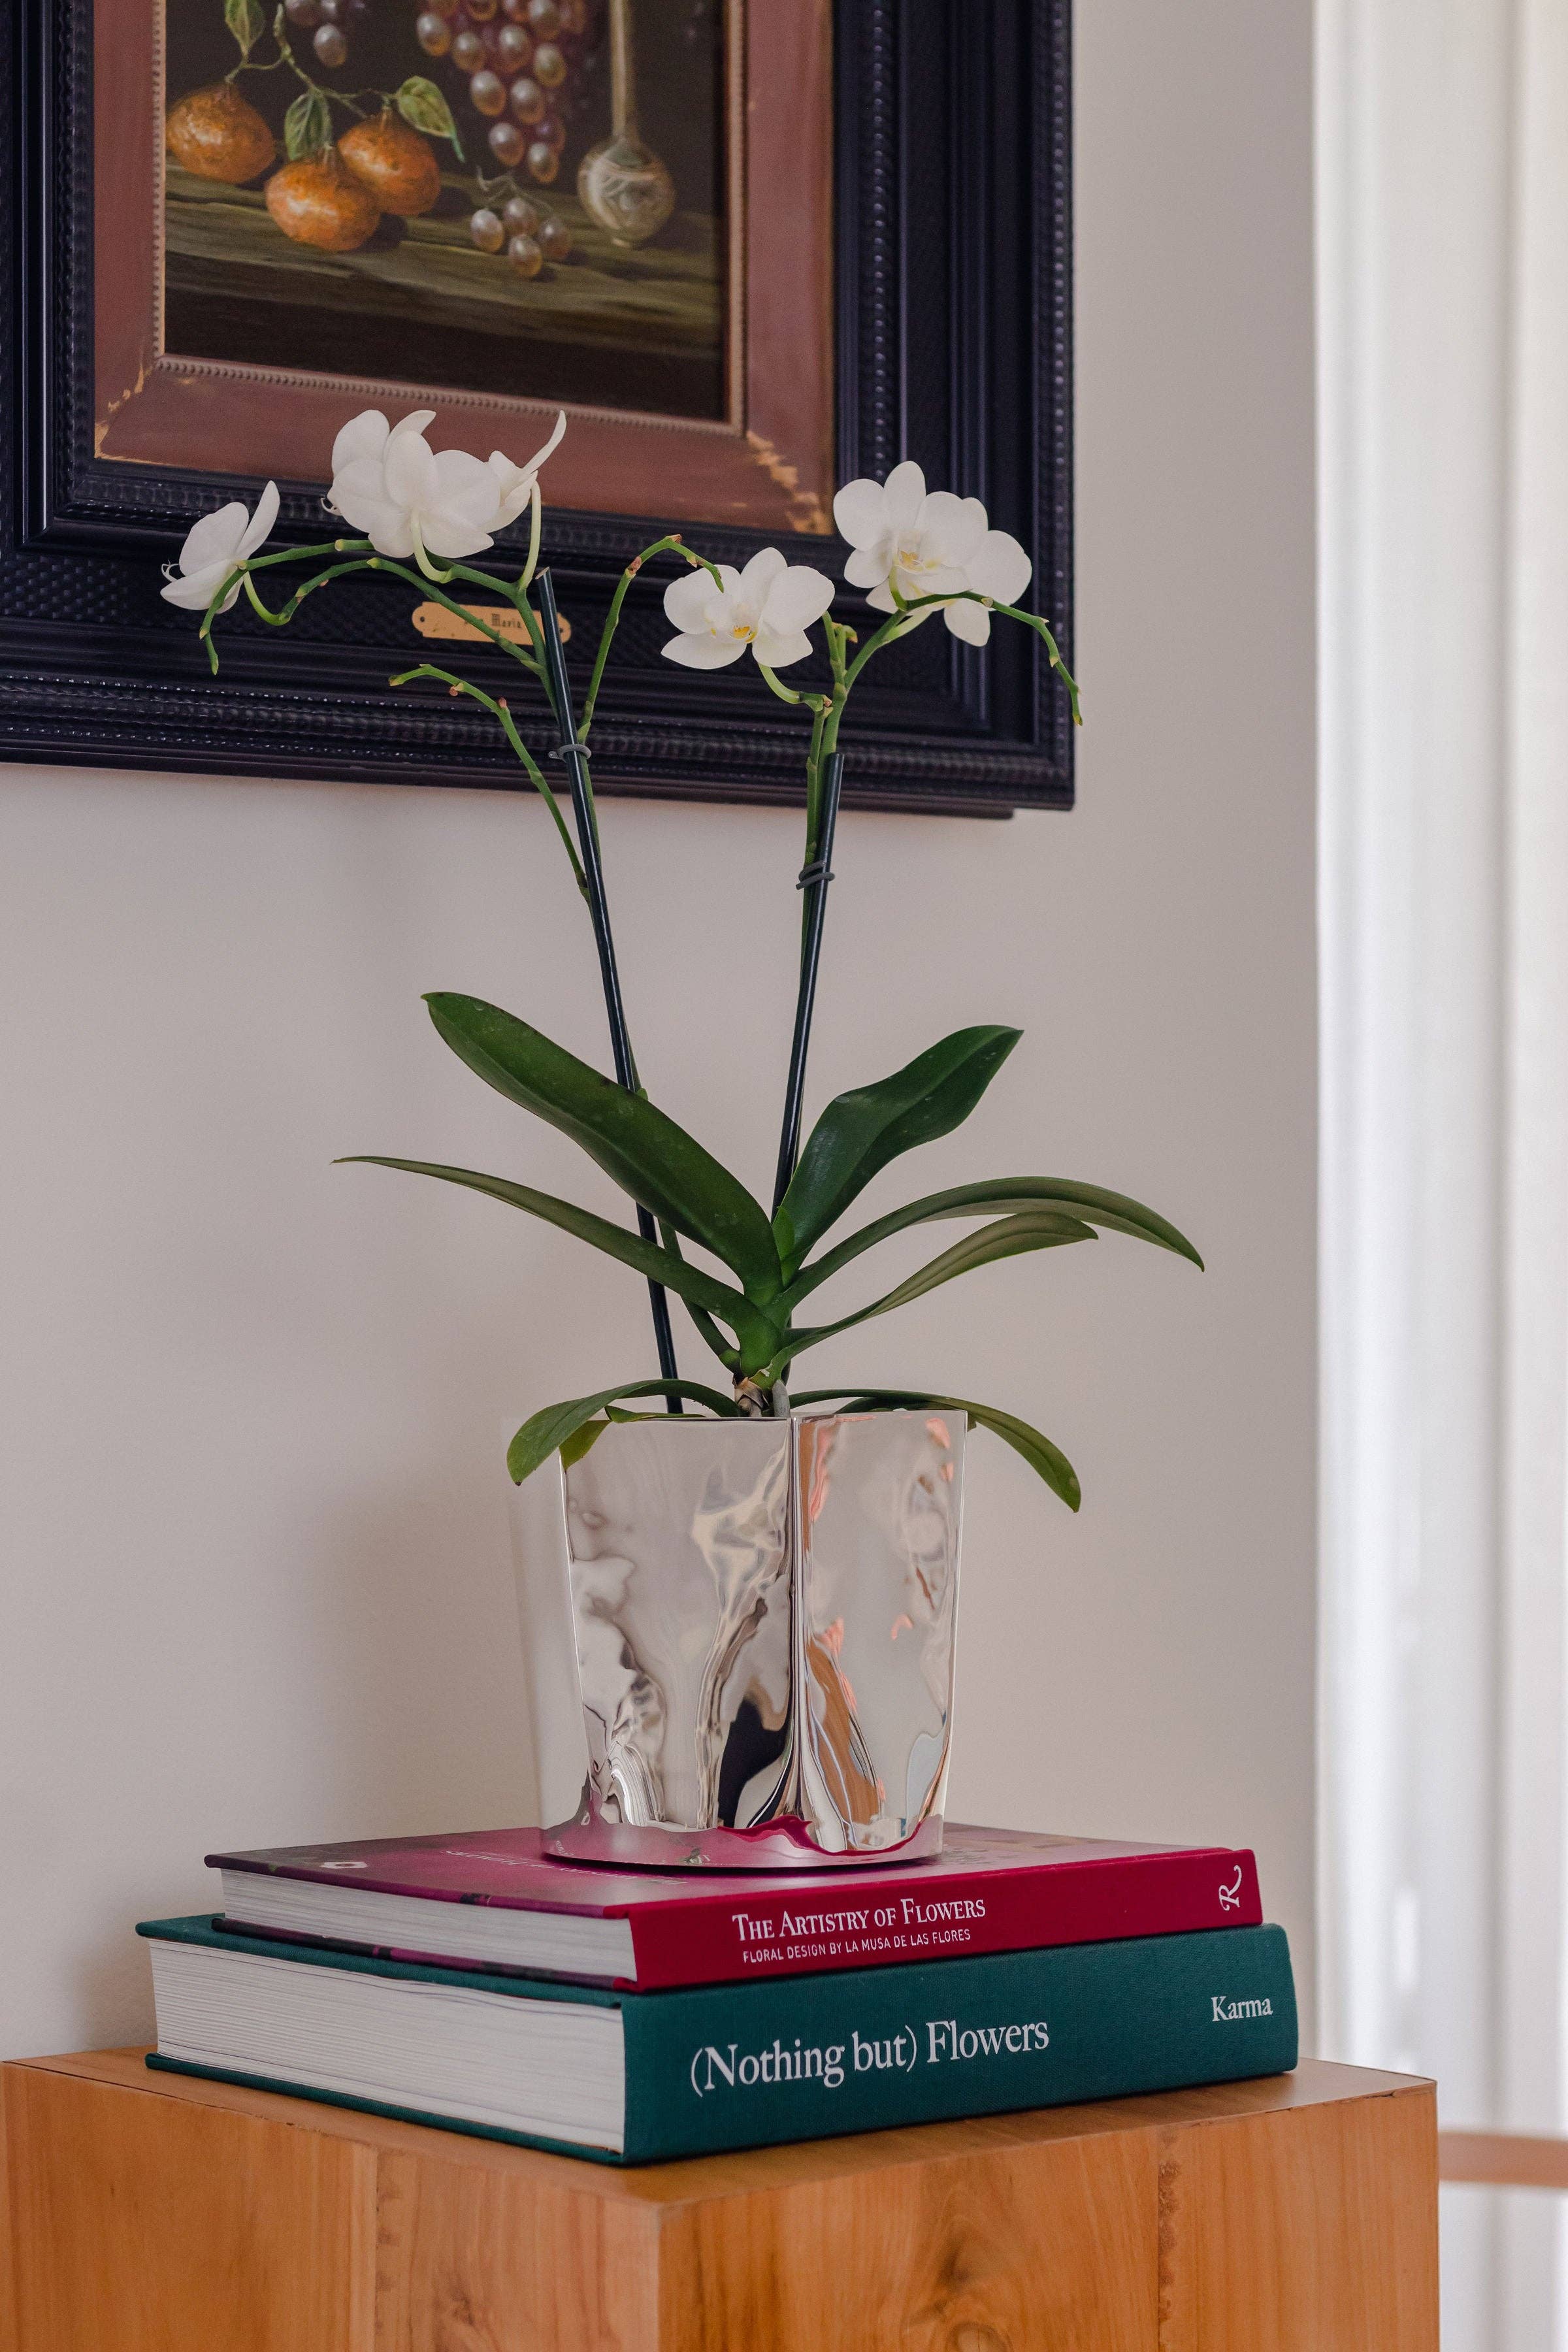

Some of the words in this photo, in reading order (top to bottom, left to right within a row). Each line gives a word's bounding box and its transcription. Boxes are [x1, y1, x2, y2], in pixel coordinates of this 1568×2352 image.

[1218, 1864, 1243, 1912] R
[742, 1948, 785, 1963] FLORAL
[786, 1943, 826, 1959] DESIGN
[829, 1942, 842, 1955] BY
[845, 1940, 860, 1953] LA
[860, 1936, 892, 1952] MUSA
[892, 1935, 908, 1948] DE
[910, 1933, 930, 1947] LAS
[932, 1928, 972, 1944] FLORES
[1210, 1995, 1274, 2023] Karma
[690, 2038, 845, 2097] (Nothing
[851, 2024, 918, 2074] but)
[925, 2019, 1050, 2063] Flowers
